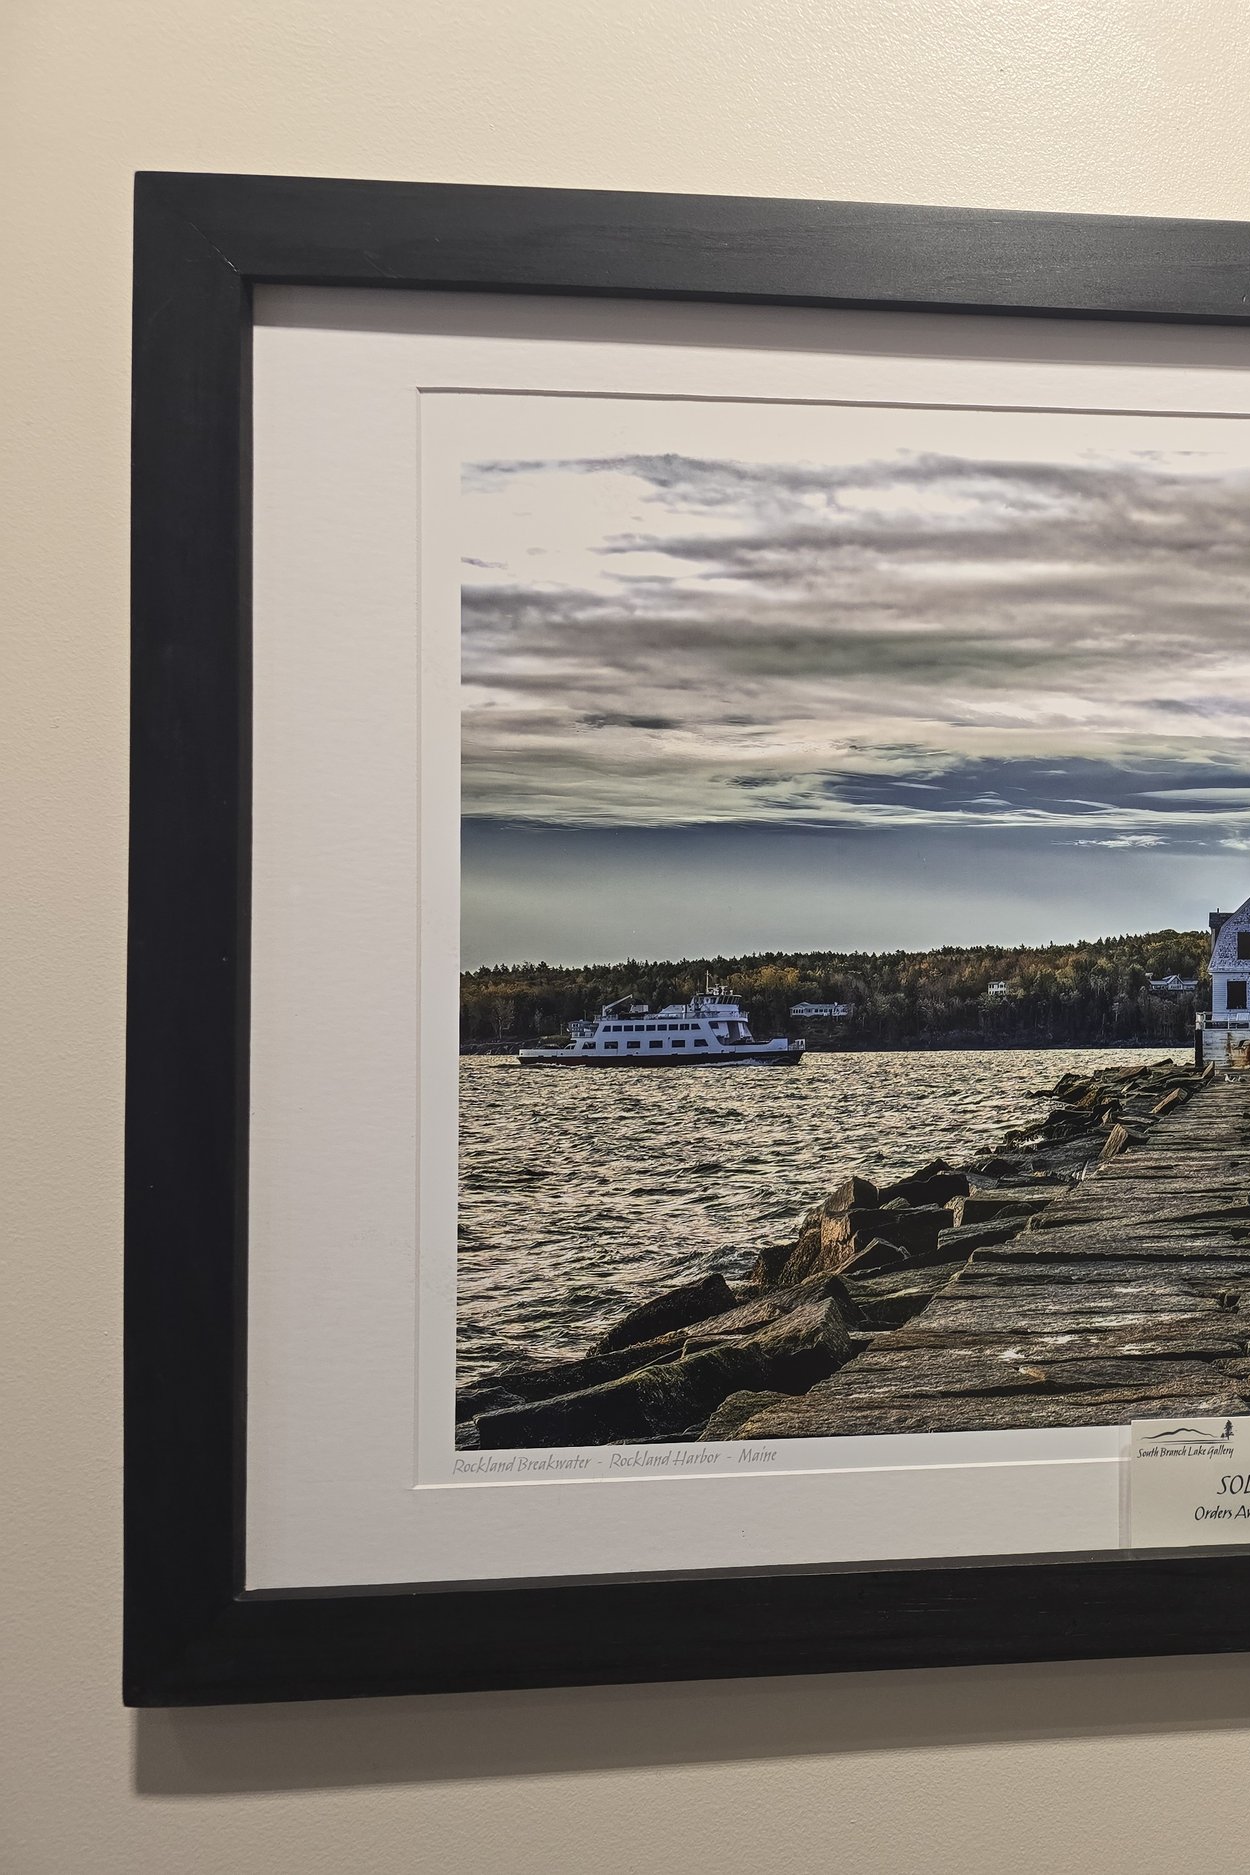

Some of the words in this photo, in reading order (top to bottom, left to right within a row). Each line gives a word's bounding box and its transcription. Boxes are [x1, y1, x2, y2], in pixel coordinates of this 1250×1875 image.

[1137, 1447, 1159, 1459] South
[1160, 1446, 1187, 1457] Branch
[1188, 1446, 1207, 1456] Lake
[1207, 1445, 1234, 1459] Gallery
[453, 1455, 514, 1475] Rockland
[517, 1454, 593, 1472] Breakwater
[609, 1450, 671, 1469] Rockland
[672, 1449, 721, 1467] Harbor
[737, 1446, 778, 1464] Maine
[1194, 1505, 1233, 1521] Orders
